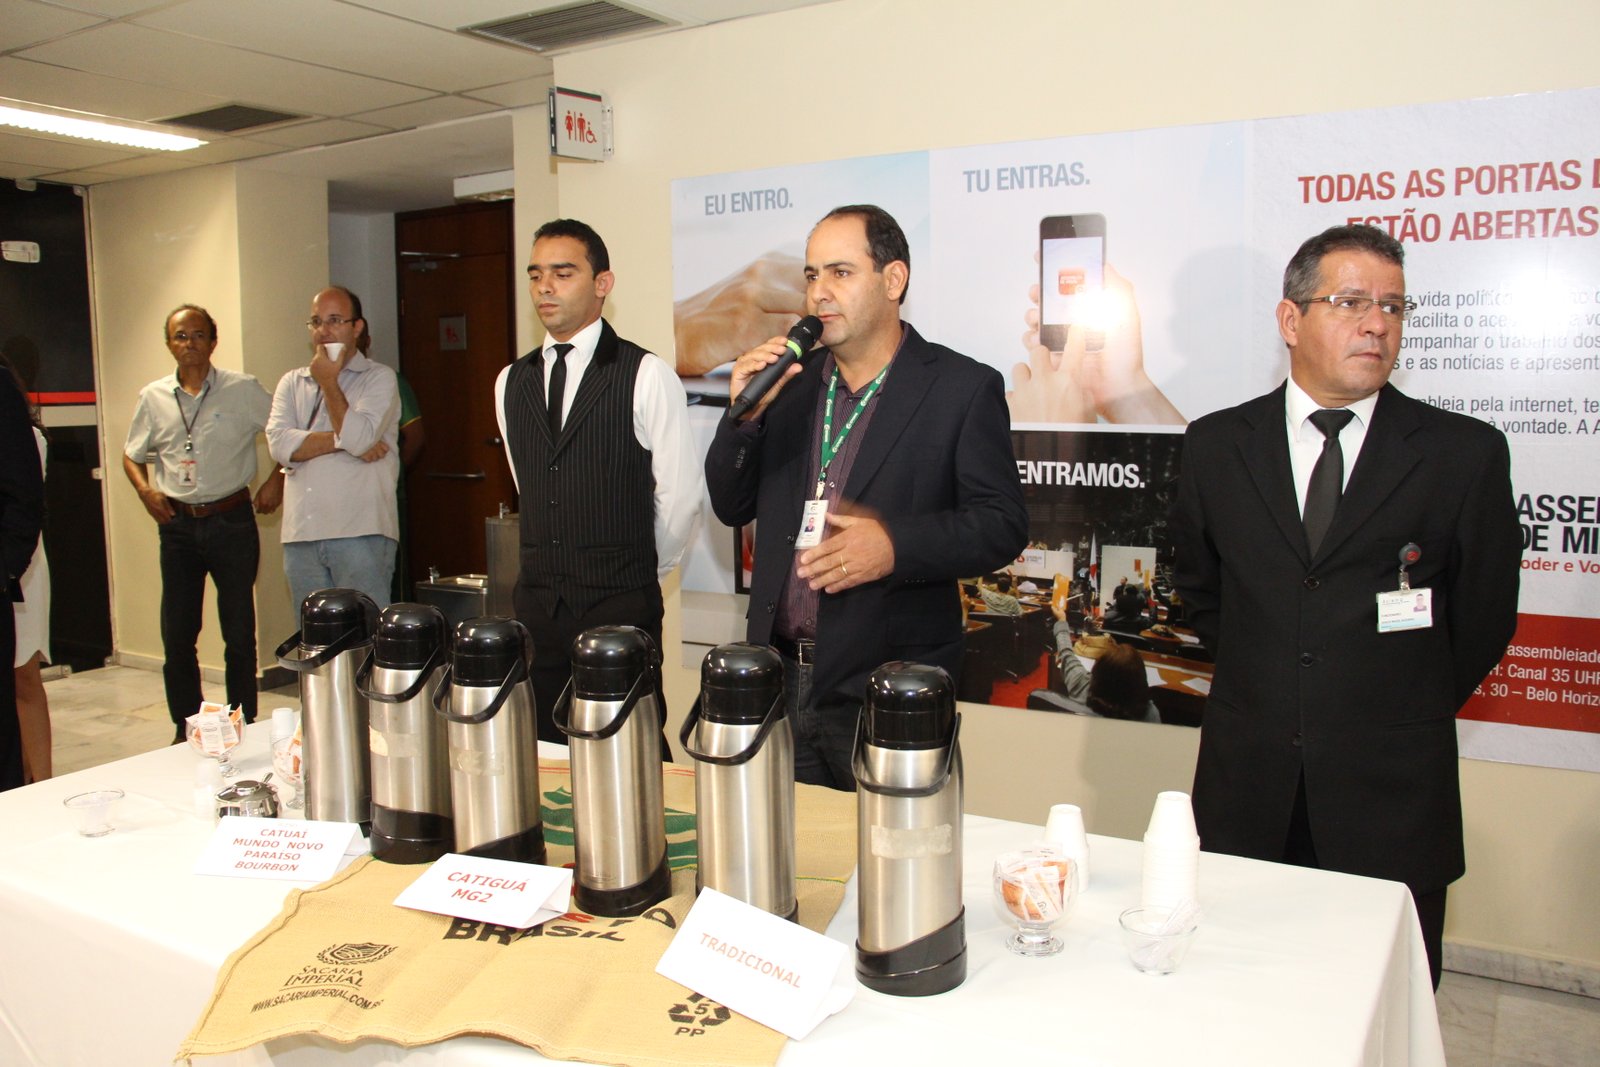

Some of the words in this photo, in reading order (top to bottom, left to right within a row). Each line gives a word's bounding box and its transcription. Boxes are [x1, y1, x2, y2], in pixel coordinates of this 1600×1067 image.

[962, 169, 990, 193] TU
[996, 161, 1090, 191] ENTRAS.
[1298, 171, 1396, 204] TODAS
[1403, 168, 1446, 199] AS
[1454, 159, 1582, 196] PORTAS
[704, 194, 726, 216] EU
[730, 187, 793, 213] ENTRO.
[1346, 208, 1441, 243] TÃO
[1449, 205, 1599, 241] ABERTAS
[1418, 291, 1451, 307] vida
[1400, 333, 1480, 352] ompanhar
[1405, 357, 1415, 370] e
[1419, 357, 1438, 370] as
[1443, 353, 1505, 370] notícias
[1470, 396, 1504, 414] pela
[1509, 396, 1578, 416] internet,
[1502, 418, 1572, 434] vontade.
[1576, 418, 1589, 435] A
[1016, 460, 1145, 488] ENTRAMOS.
[1516, 493, 1600, 524] ASSE
[1520, 557, 1559, 571] oder
[1563, 561, 1574, 572] e
[1507, 663, 1547, 681] Canal
[1551, 667, 1570, 683] 35
[1490, 682, 1508, 698] 30
[1526, 685, 1558, 703] Belo
[1562, 689, 1600, 707] Horiz
[260, 826, 308, 839] CATUAÍ
[232, 838, 280, 848] MUNDO
[286, 841, 324, 851] NOVO
[243, 849, 301, 861] PARAÍSO
[234, 860, 299, 872] BOURBON
[447, 871, 530, 892] CATIGUÁ
[450, 888, 493, 903] MG2
[700, 932, 801, 988] TRADICIONAL
[299, 965, 363, 977] SACARIA
[283, 974, 364, 988] IMPERIAL
[694, 1003, 711, 1015] 5
[674, 1026, 706, 1037] PP
